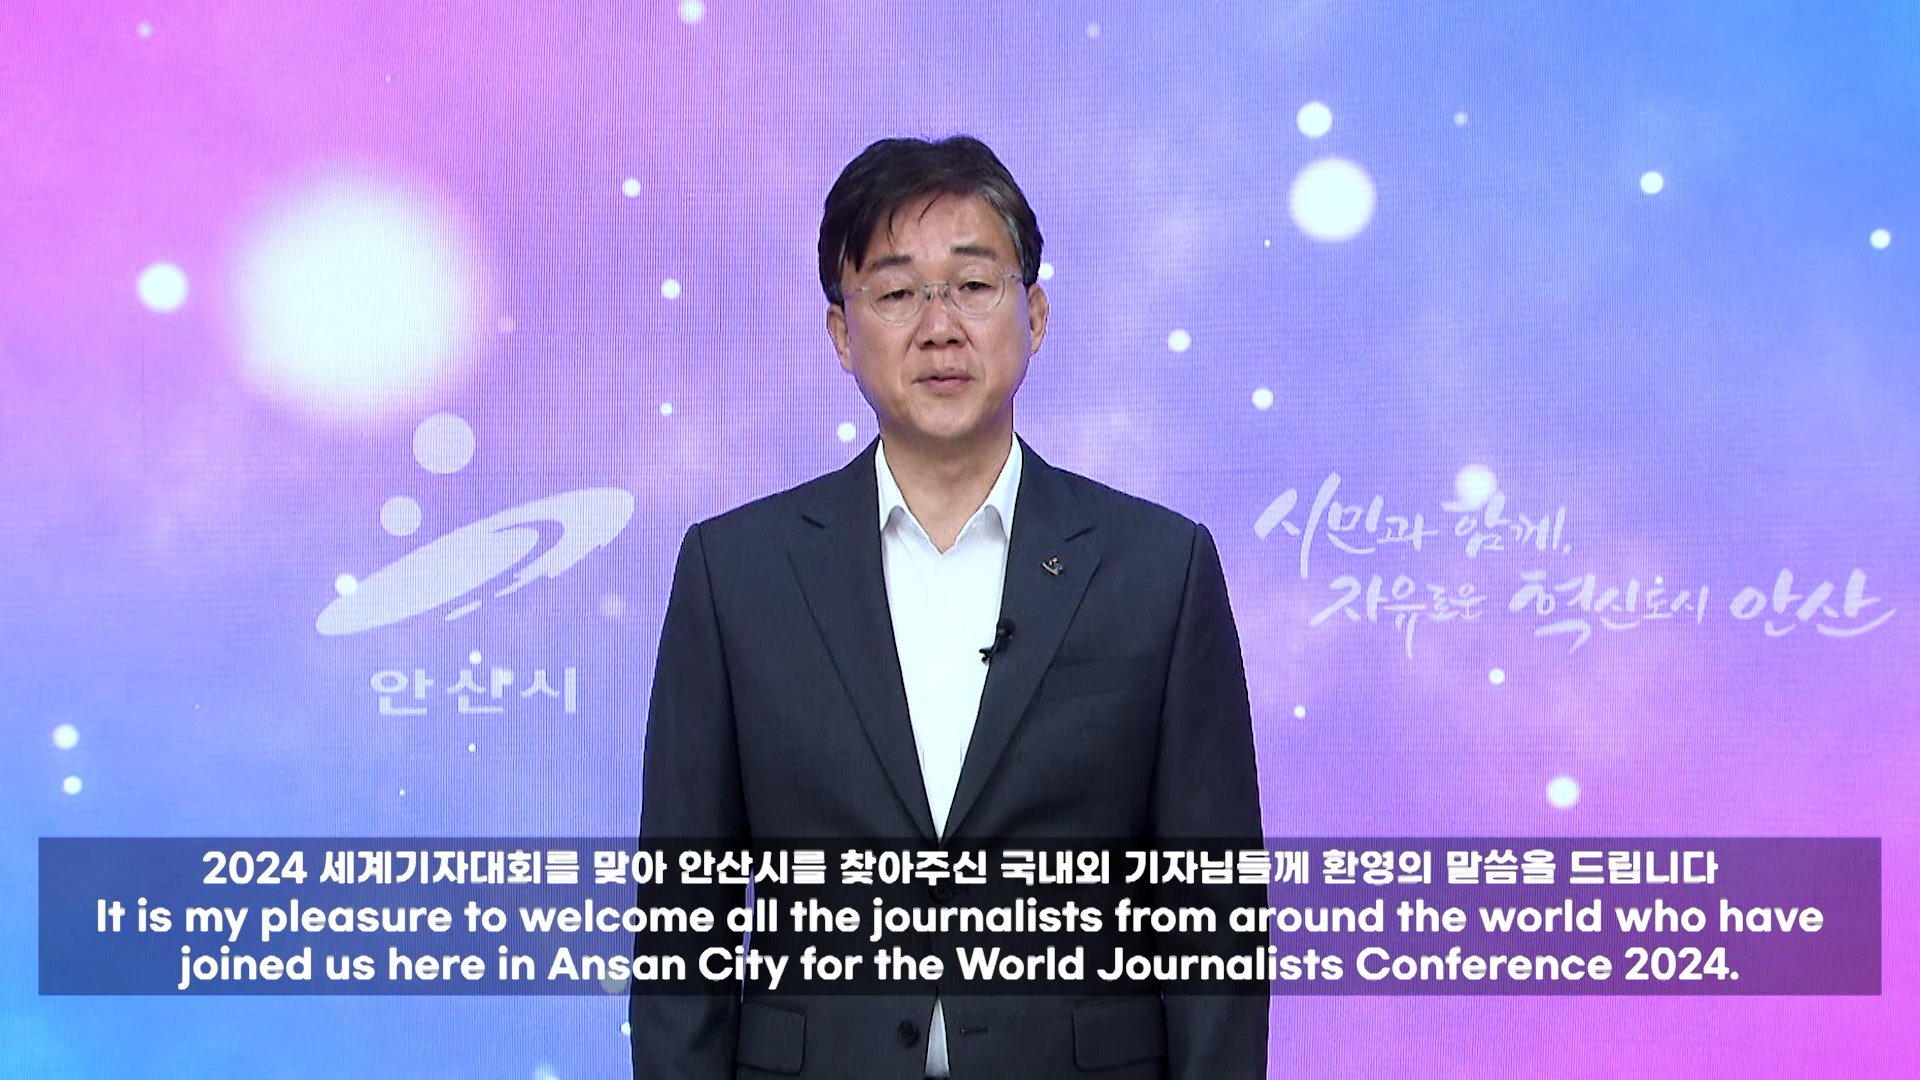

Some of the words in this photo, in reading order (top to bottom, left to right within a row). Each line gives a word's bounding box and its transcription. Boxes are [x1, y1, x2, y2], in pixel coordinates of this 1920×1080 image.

[1254, 471, 1438, 580] 시민과
[1310, 573, 1487, 660] 자유로운
[1508, 570, 1709, 655] 혁신도시
[1730, 567, 1897, 637] 안산
[369, 666, 577, 716] 안산시
